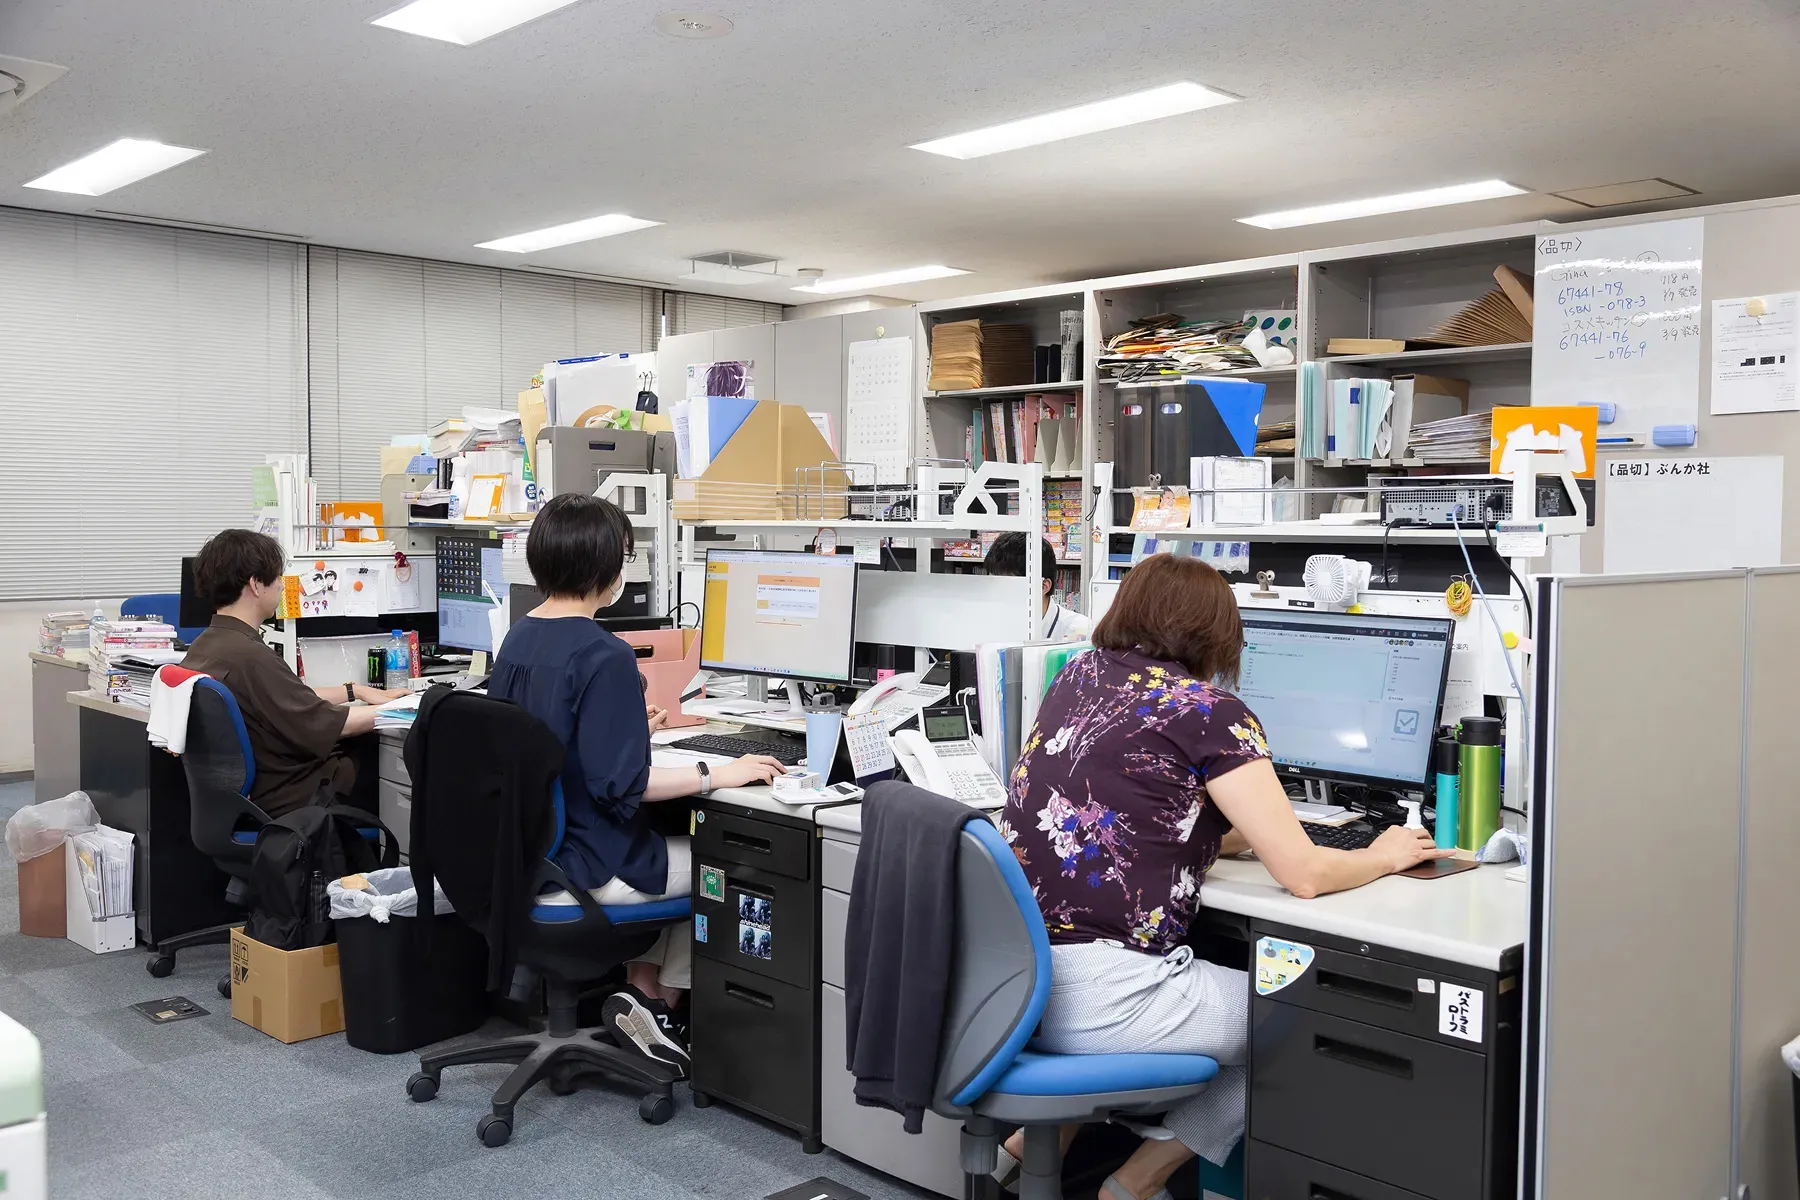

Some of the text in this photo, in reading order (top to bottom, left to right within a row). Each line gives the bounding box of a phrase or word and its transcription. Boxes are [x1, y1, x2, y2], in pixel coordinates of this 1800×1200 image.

[1558, 281, 1624, 305] 67441-78
[1564, 303, 1592, 317] ISBN
[1560, 329, 1629, 350] 67441-76
[1448, 1004, 1459, 1033] ローフ
[1458, 990, 1471, 1035] パストラミ
